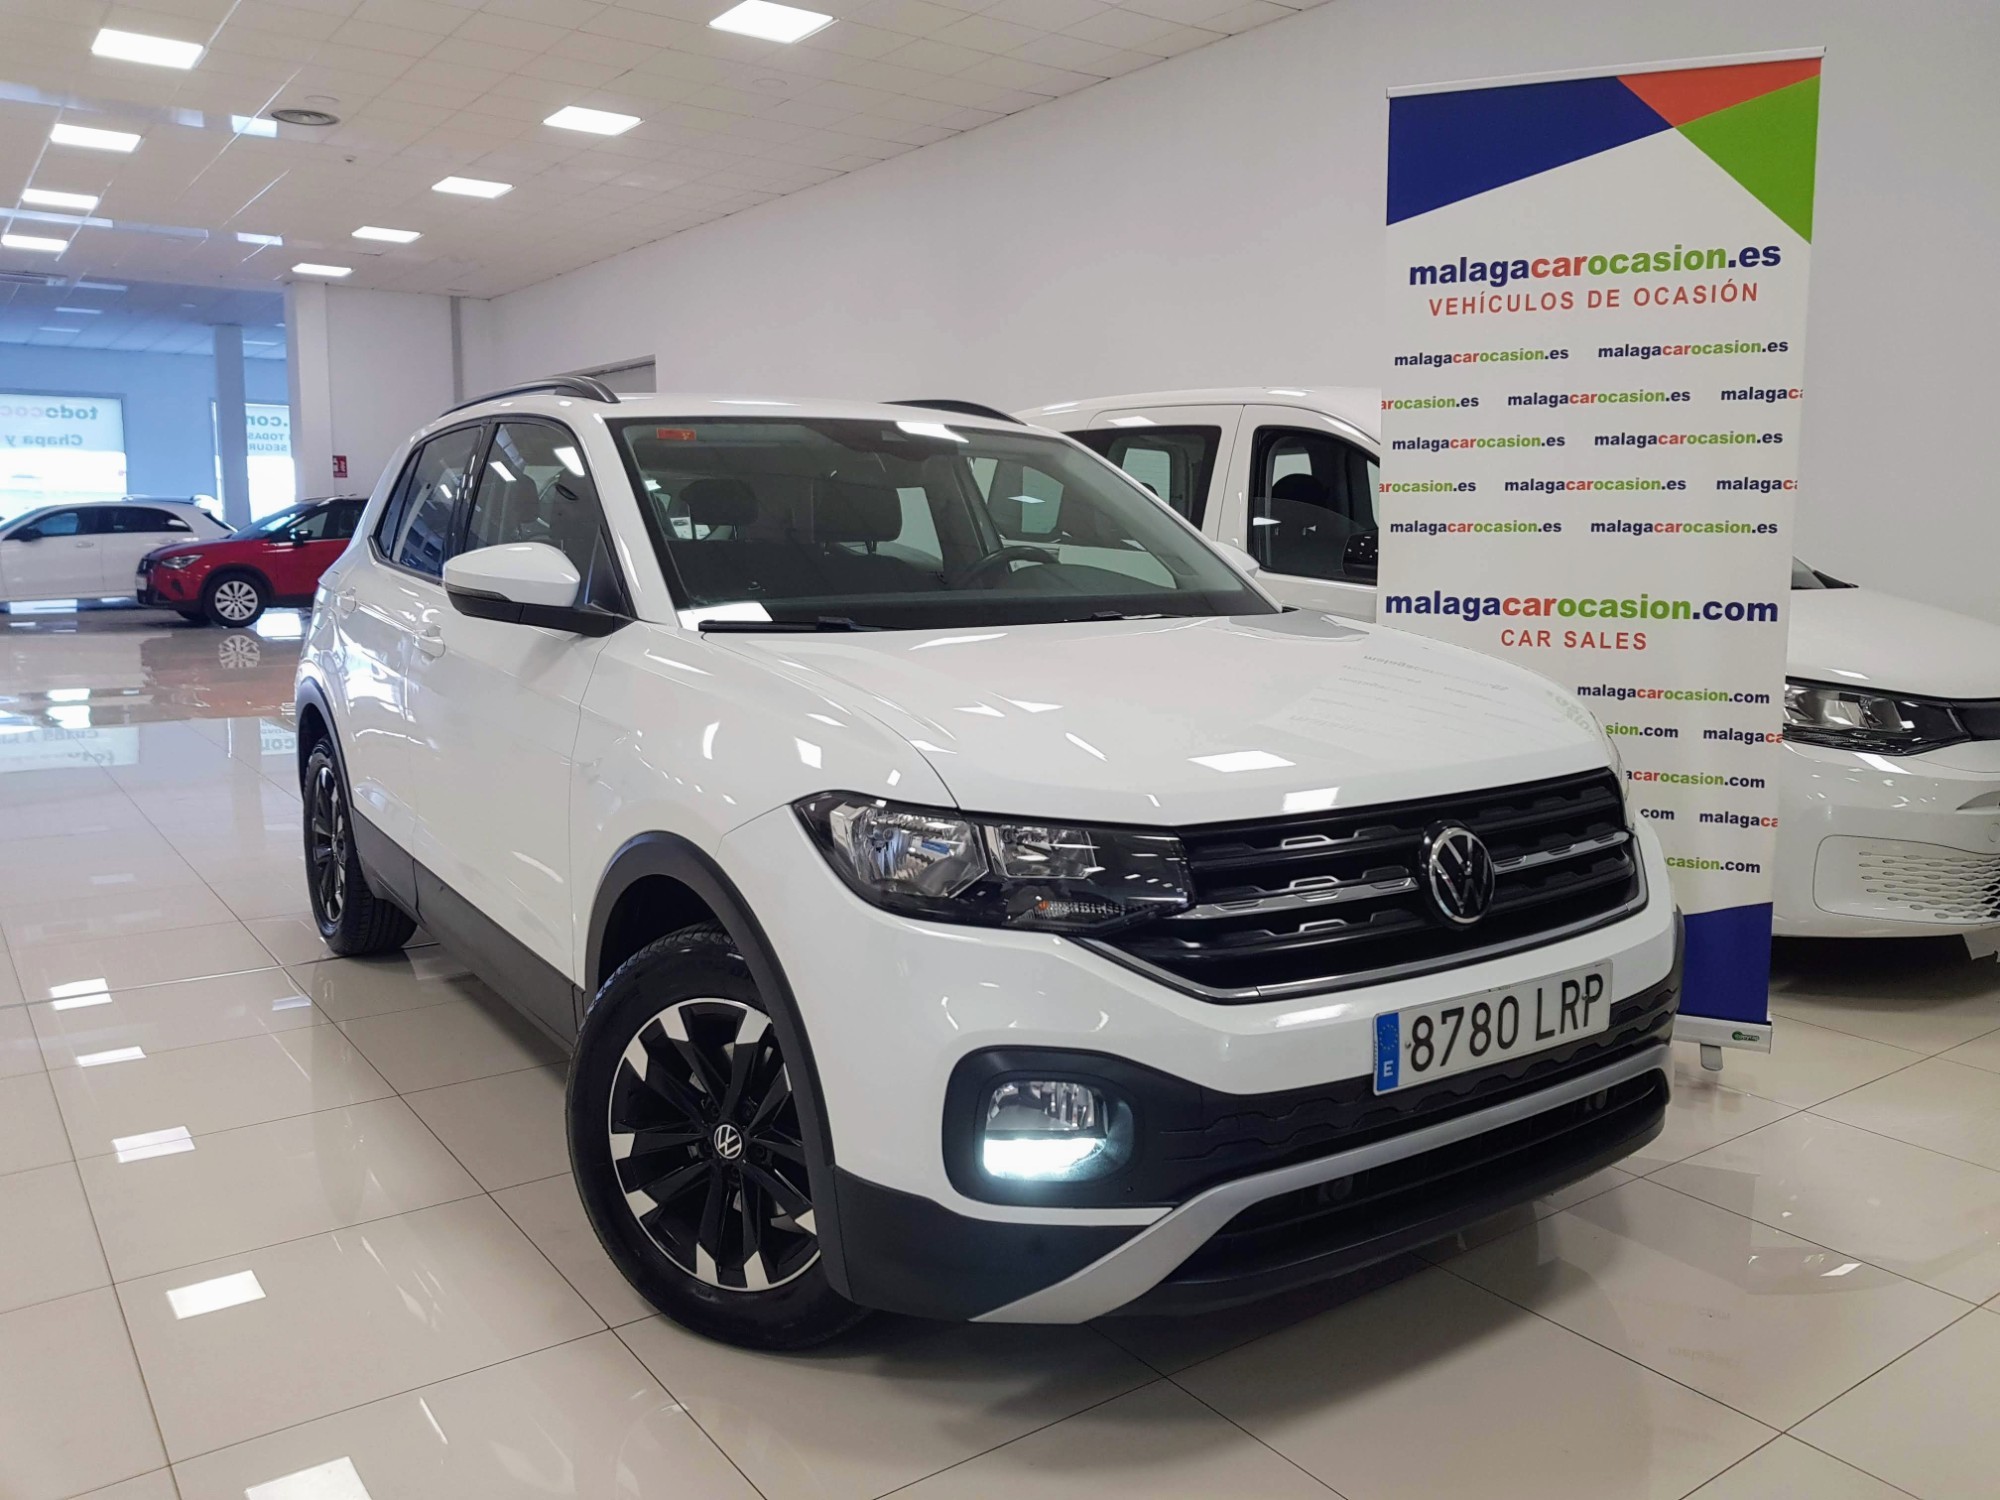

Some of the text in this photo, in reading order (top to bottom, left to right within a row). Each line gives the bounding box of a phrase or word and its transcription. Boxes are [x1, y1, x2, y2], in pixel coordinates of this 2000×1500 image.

[1409, 243, 1782, 288] malagacarocasion.es
[1428, 278, 1758, 317] VEHÍCULOS DE OCASIÓN
[1394, 347, 1570, 368] malagacarocasion.es
[1597, 339, 1789, 360] malagacarocasion.es
[1507, 389, 1691, 408] malagacarocasion.es
[1392, 434, 1566, 453] malagacarocasion.es
[1594, 430, 1784, 449] malagacarocasion.es
[1504, 477, 1687, 494] malagacarocasion.es
[1389, 519, 1562, 536] malagacarocasion.es
[1590, 519, 1778, 537] malagacarocasion.es
[1385, 590, 1779, 623] malagacarocasion.com
[1500, 628, 1647, 651] CAR SALES
[1577, 683, 1770, 705] malagacarocasion.com
[1664, 856, 1761, 874] casion.com
[1410, 973, 1604, 1073] 8780 LRP
[1383, 1060, 1394, 1078] E
